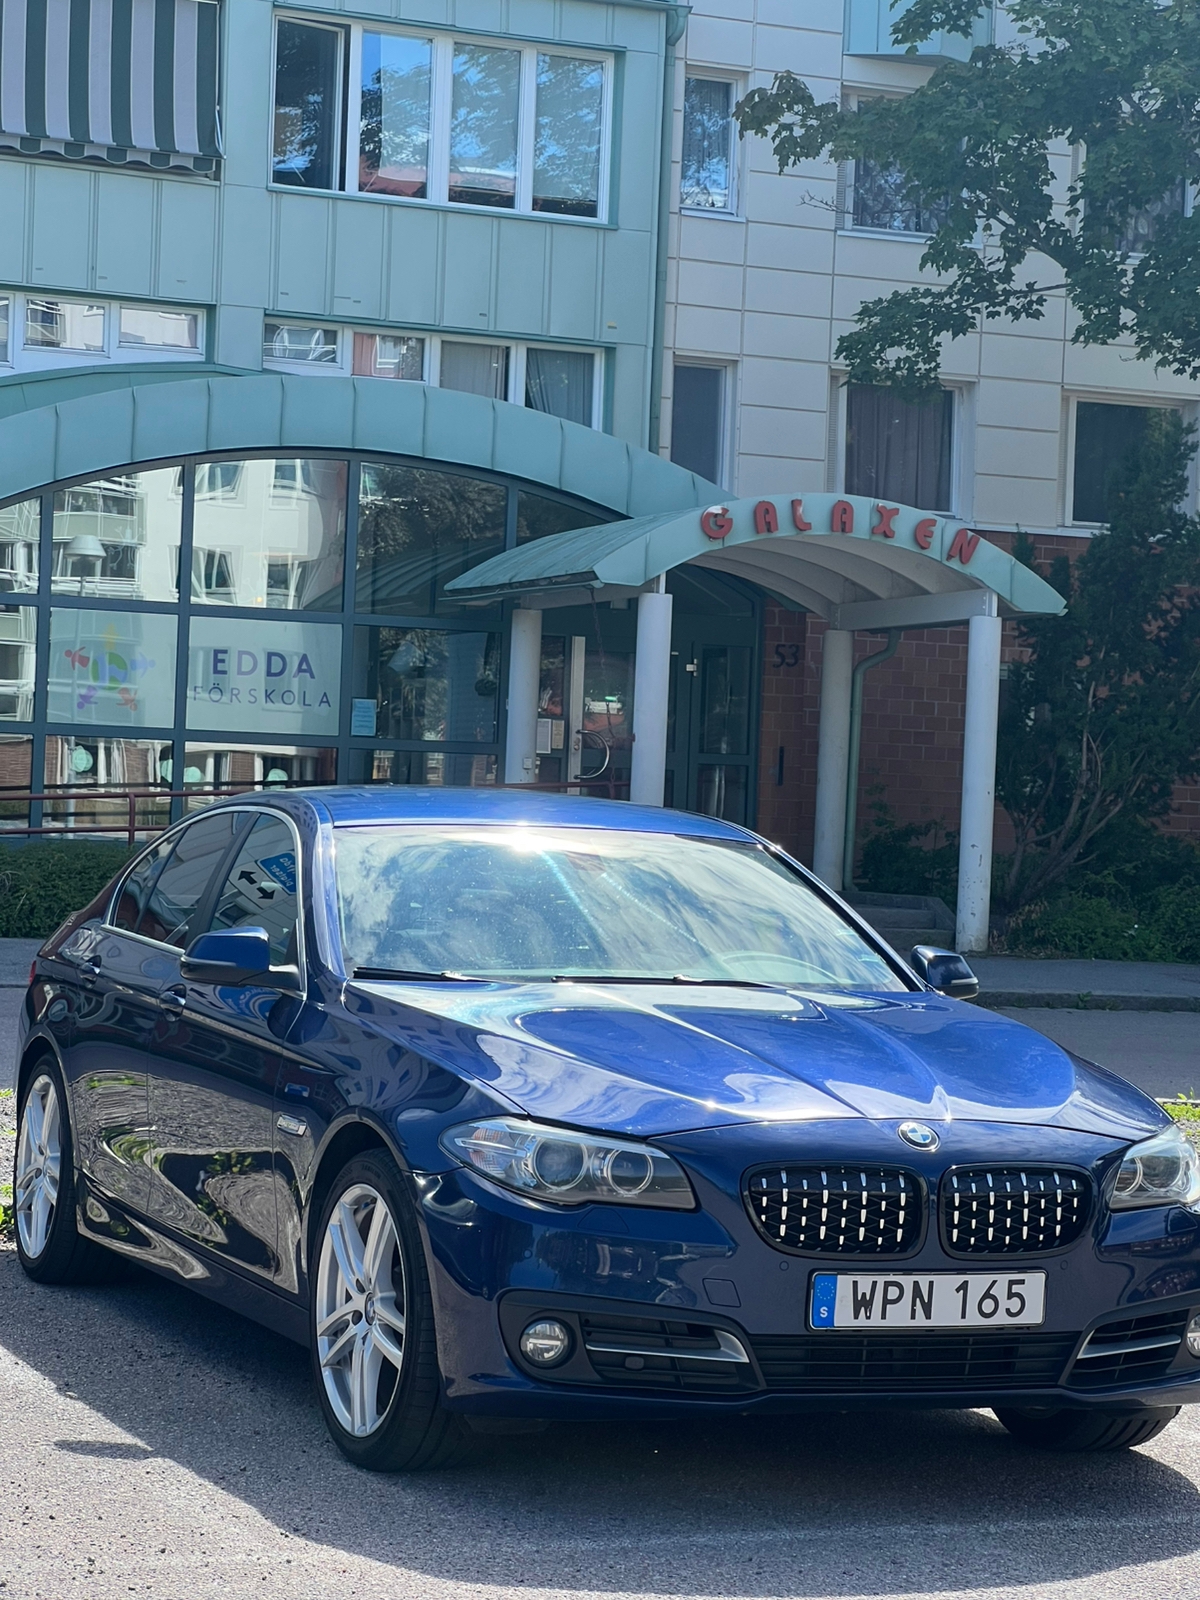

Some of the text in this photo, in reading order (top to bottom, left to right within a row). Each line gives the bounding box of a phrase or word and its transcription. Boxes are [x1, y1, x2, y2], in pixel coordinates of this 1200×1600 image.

[701, 498, 980, 564] GALAXEN
[212, 649, 316, 679] EDDA
[772, 643, 800, 668] 53
[193, 682, 331, 708] FÖRSKOLA
[819, 1306, 828, 1318] S
[852, 1278, 1026, 1321] WPN 165
